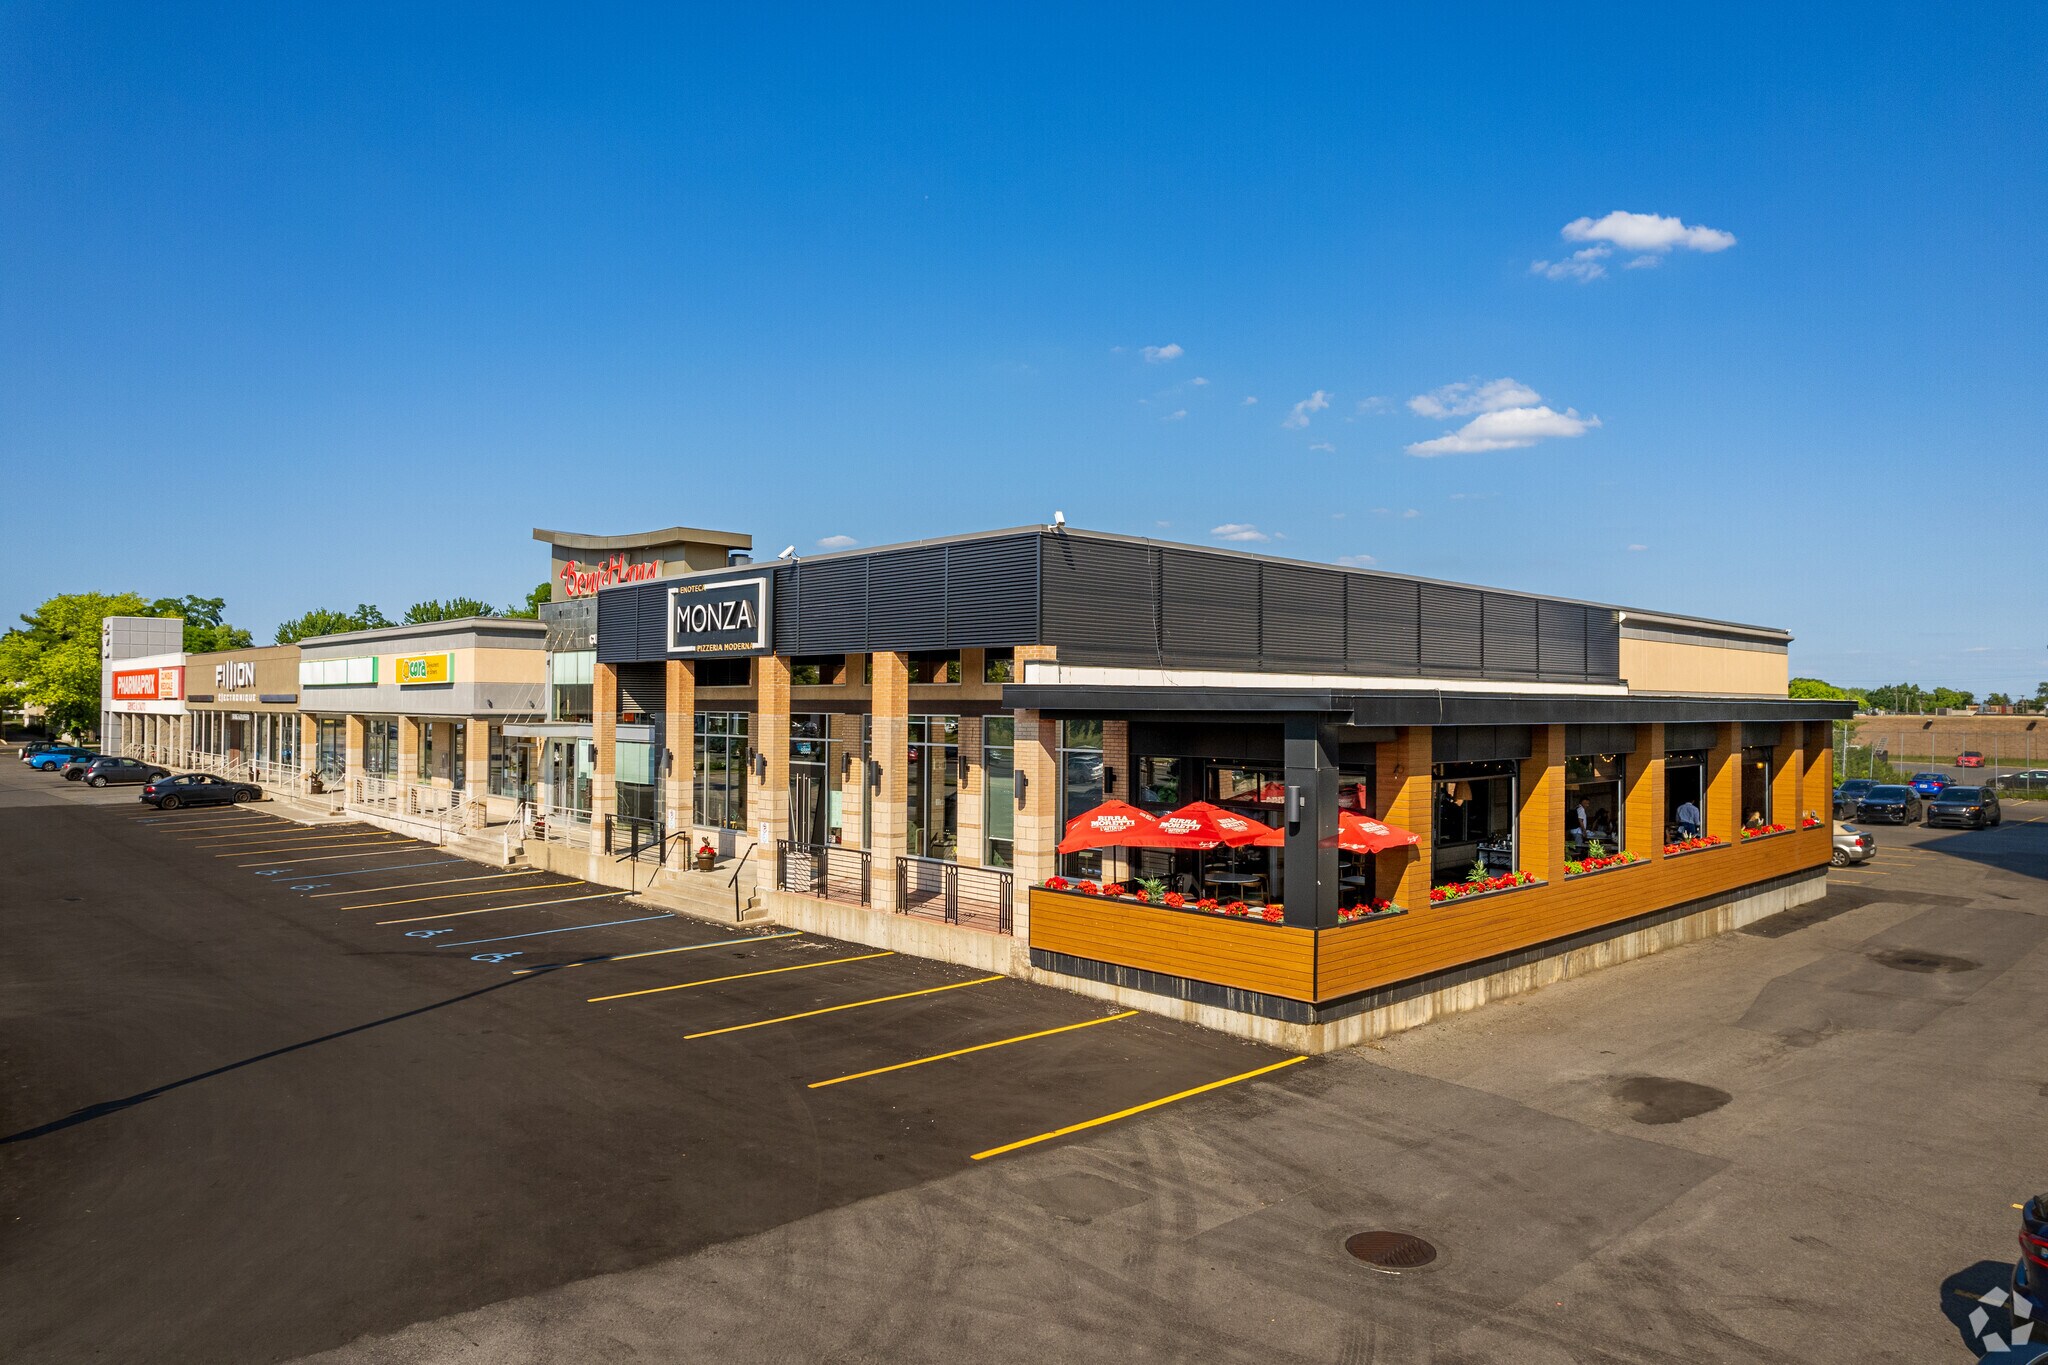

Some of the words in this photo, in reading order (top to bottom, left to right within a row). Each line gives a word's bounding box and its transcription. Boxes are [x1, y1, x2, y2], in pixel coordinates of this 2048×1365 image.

[680, 584, 706, 594] ENOTECA
[677, 600, 753, 633] MONZA
[723, 642, 753, 651] MODERNA
[117, 674, 155, 694] PHARMAPRIX
[1090, 819, 1136, 828] MORETTI
[1158, 821, 1202, 831] MORETTI
[1168, 817, 1197, 825] BIRRA
